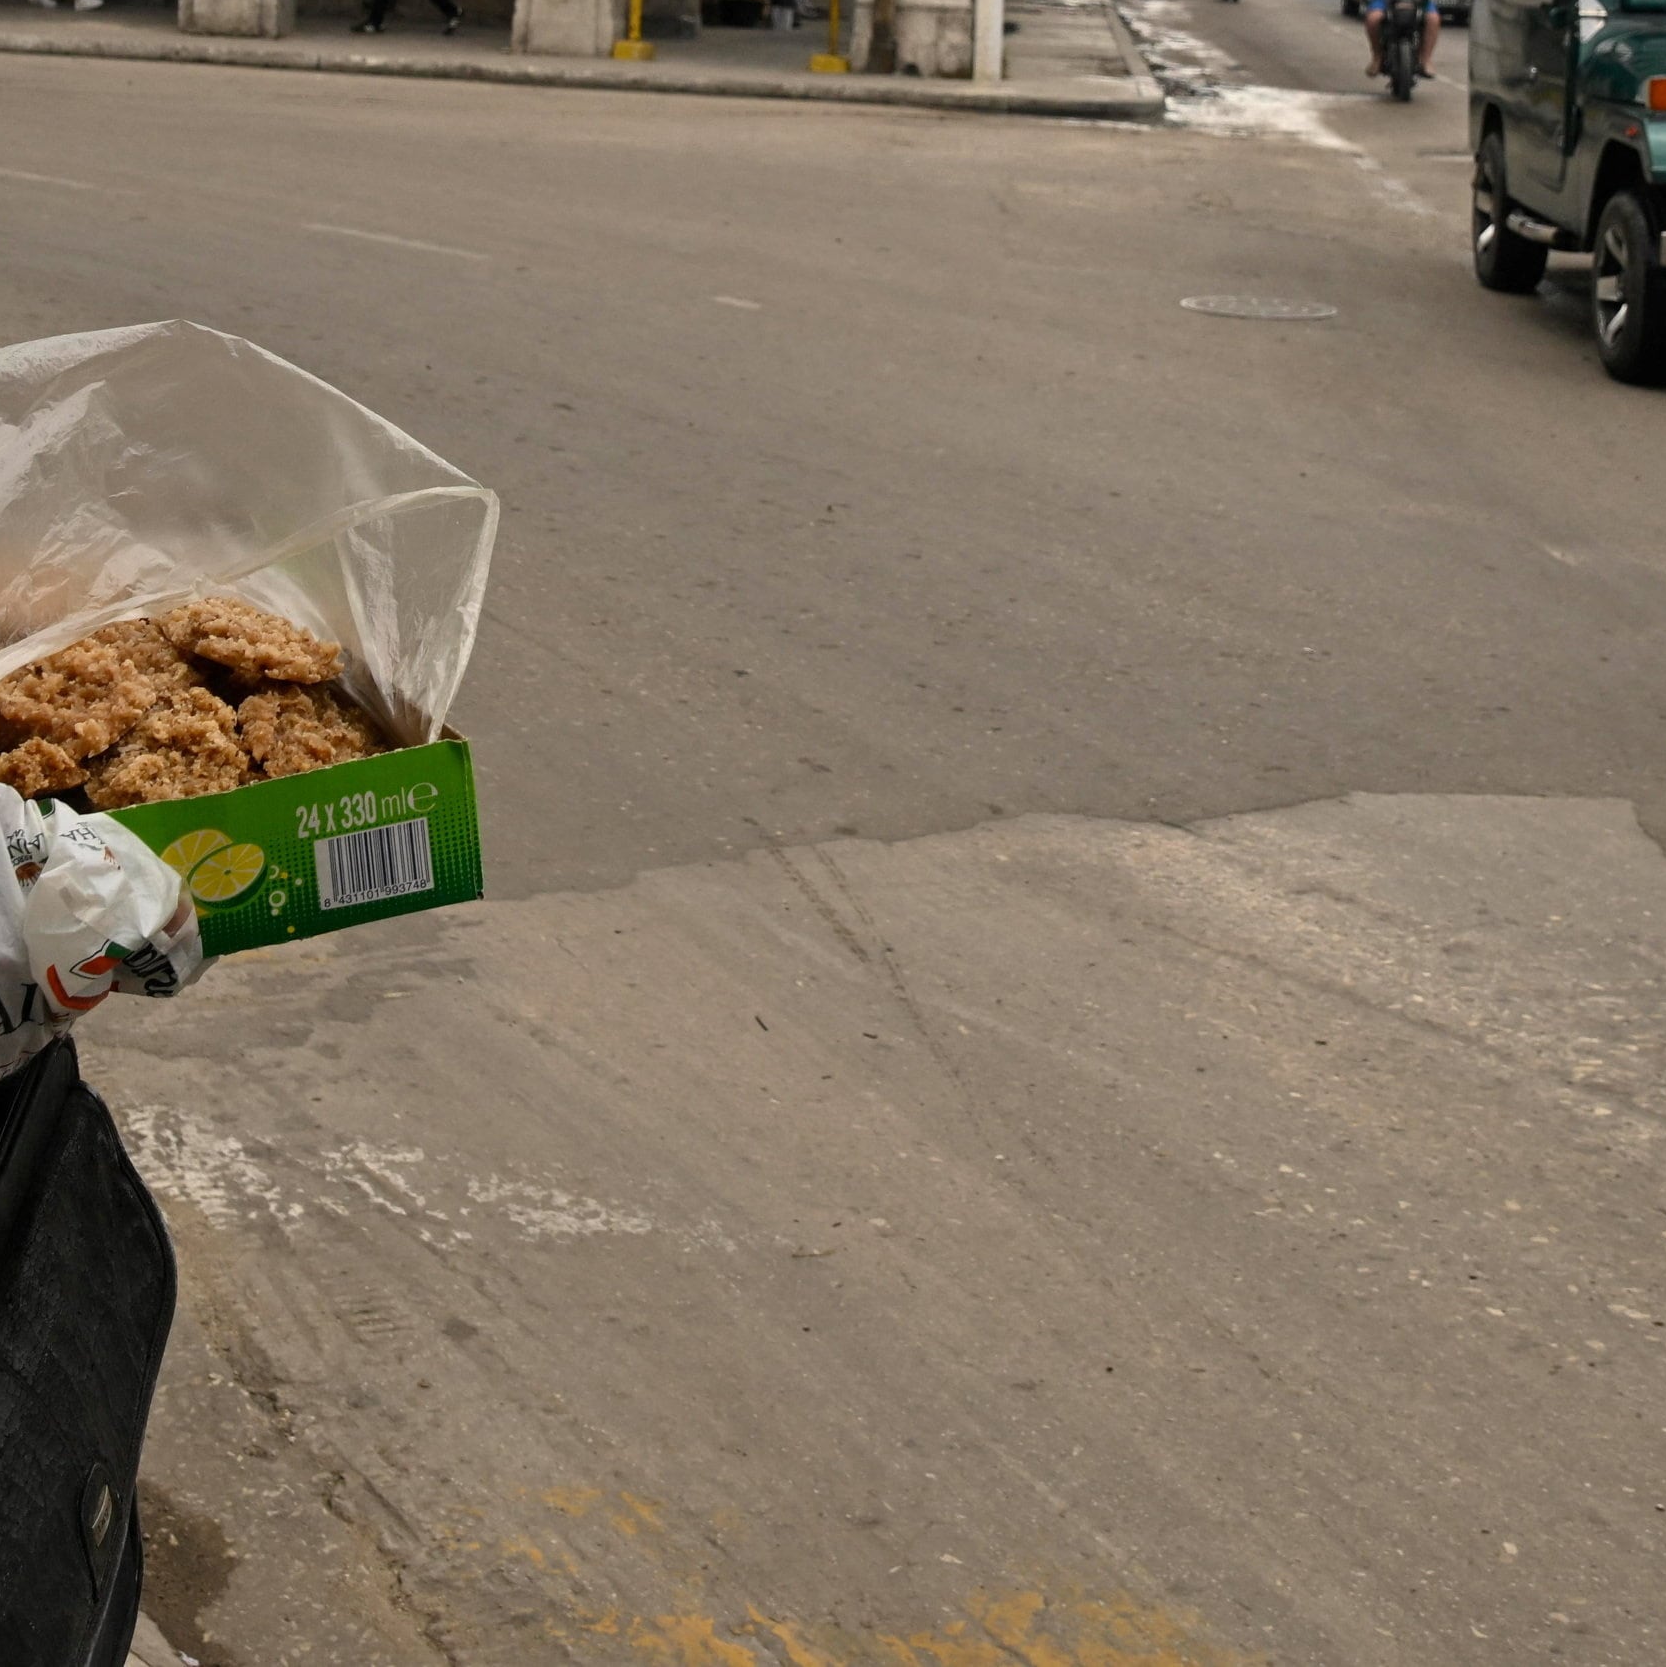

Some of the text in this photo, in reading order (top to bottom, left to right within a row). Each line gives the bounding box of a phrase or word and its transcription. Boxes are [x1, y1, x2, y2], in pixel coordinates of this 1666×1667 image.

[295, 804, 320, 838] 24
[339, 790, 377, 829] 330
[324, 878, 427, 908] 8 431101 993748
